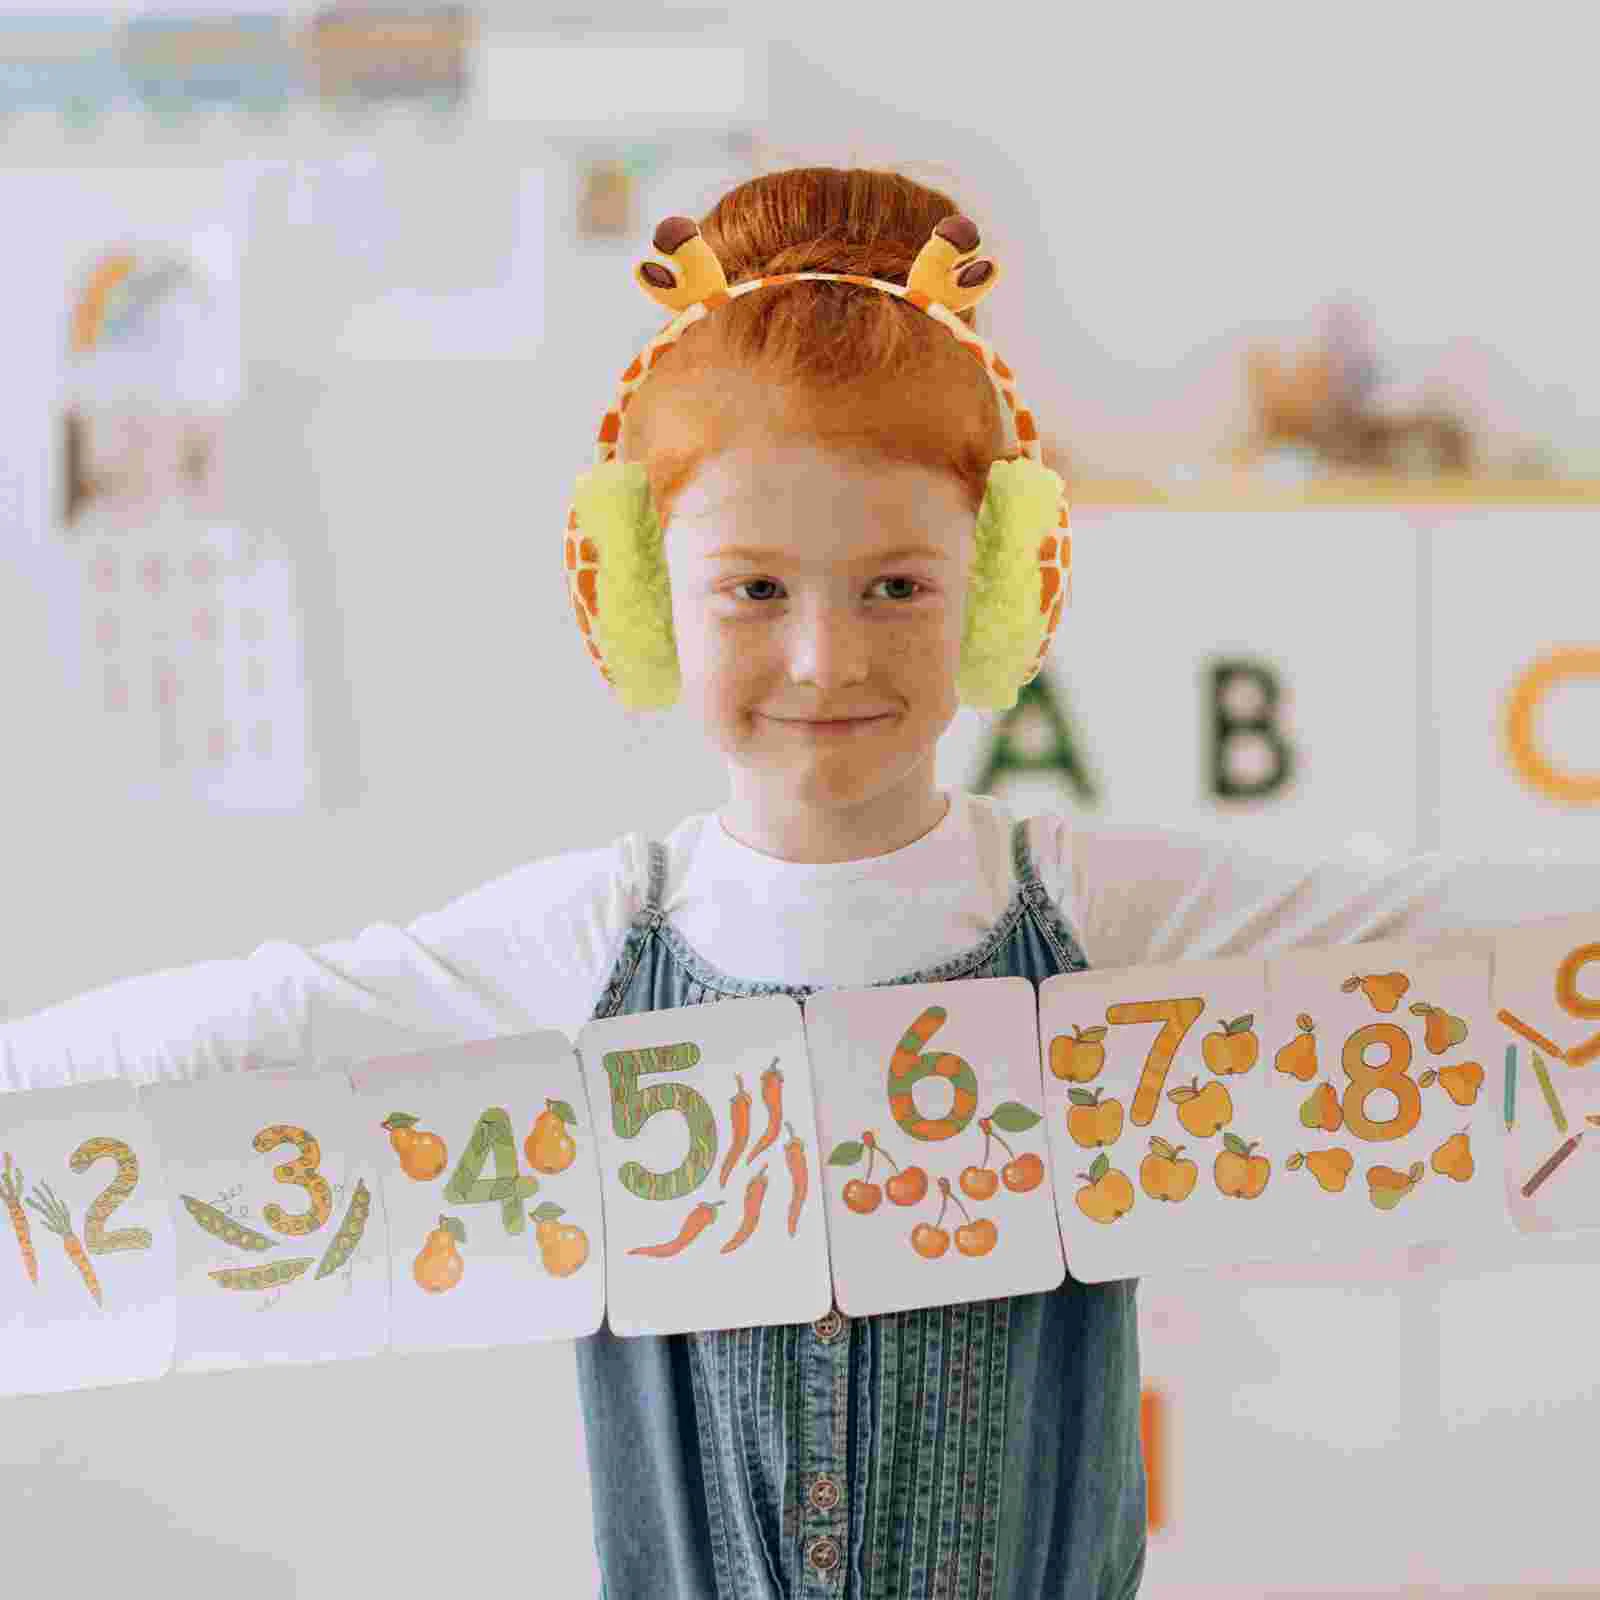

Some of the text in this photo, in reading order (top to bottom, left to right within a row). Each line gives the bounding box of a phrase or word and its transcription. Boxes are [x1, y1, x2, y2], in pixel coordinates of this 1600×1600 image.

[970, 663, 1097, 806] A
[1204, 654, 1295, 806] B
[70, 1136, 152, 1254] 2
[252, 1124, 332, 1236] 3
[443, 1107, 539, 1235] 4
[603, 1041, 718, 1200] 5
[888, 1006, 978, 1141] 6
[1106, 997, 1205, 1126] 7
[1341, 1023, 1422, 1141] 8
